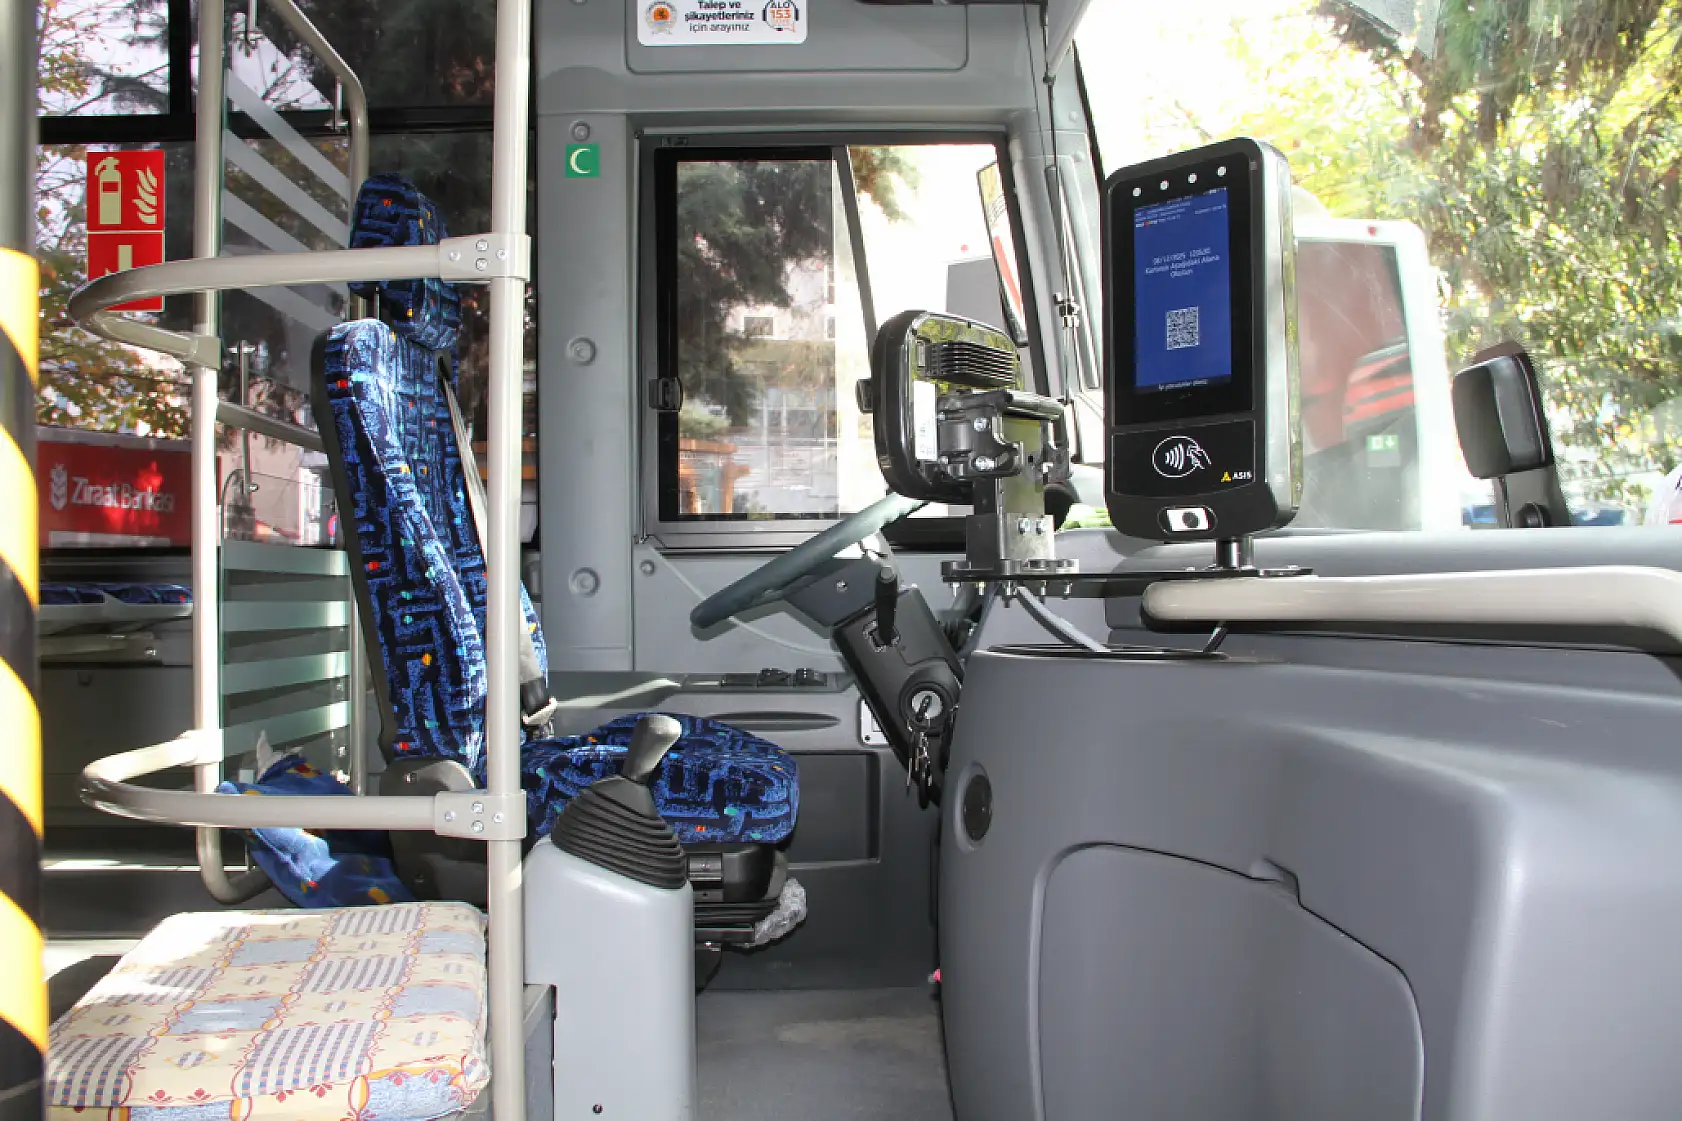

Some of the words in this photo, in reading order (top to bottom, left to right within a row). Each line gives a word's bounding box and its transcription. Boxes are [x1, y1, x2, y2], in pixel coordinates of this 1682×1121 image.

[698, 0, 726, 10] Talep
[729, 1, 741, 9] ve
[770, 0, 790, 8] ALO
[770, 9, 791, 19] 153
[689, 22, 708, 33] için
[710, 22, 750, 33] arayınız
[71, 475, 119, 508] Ziraat
